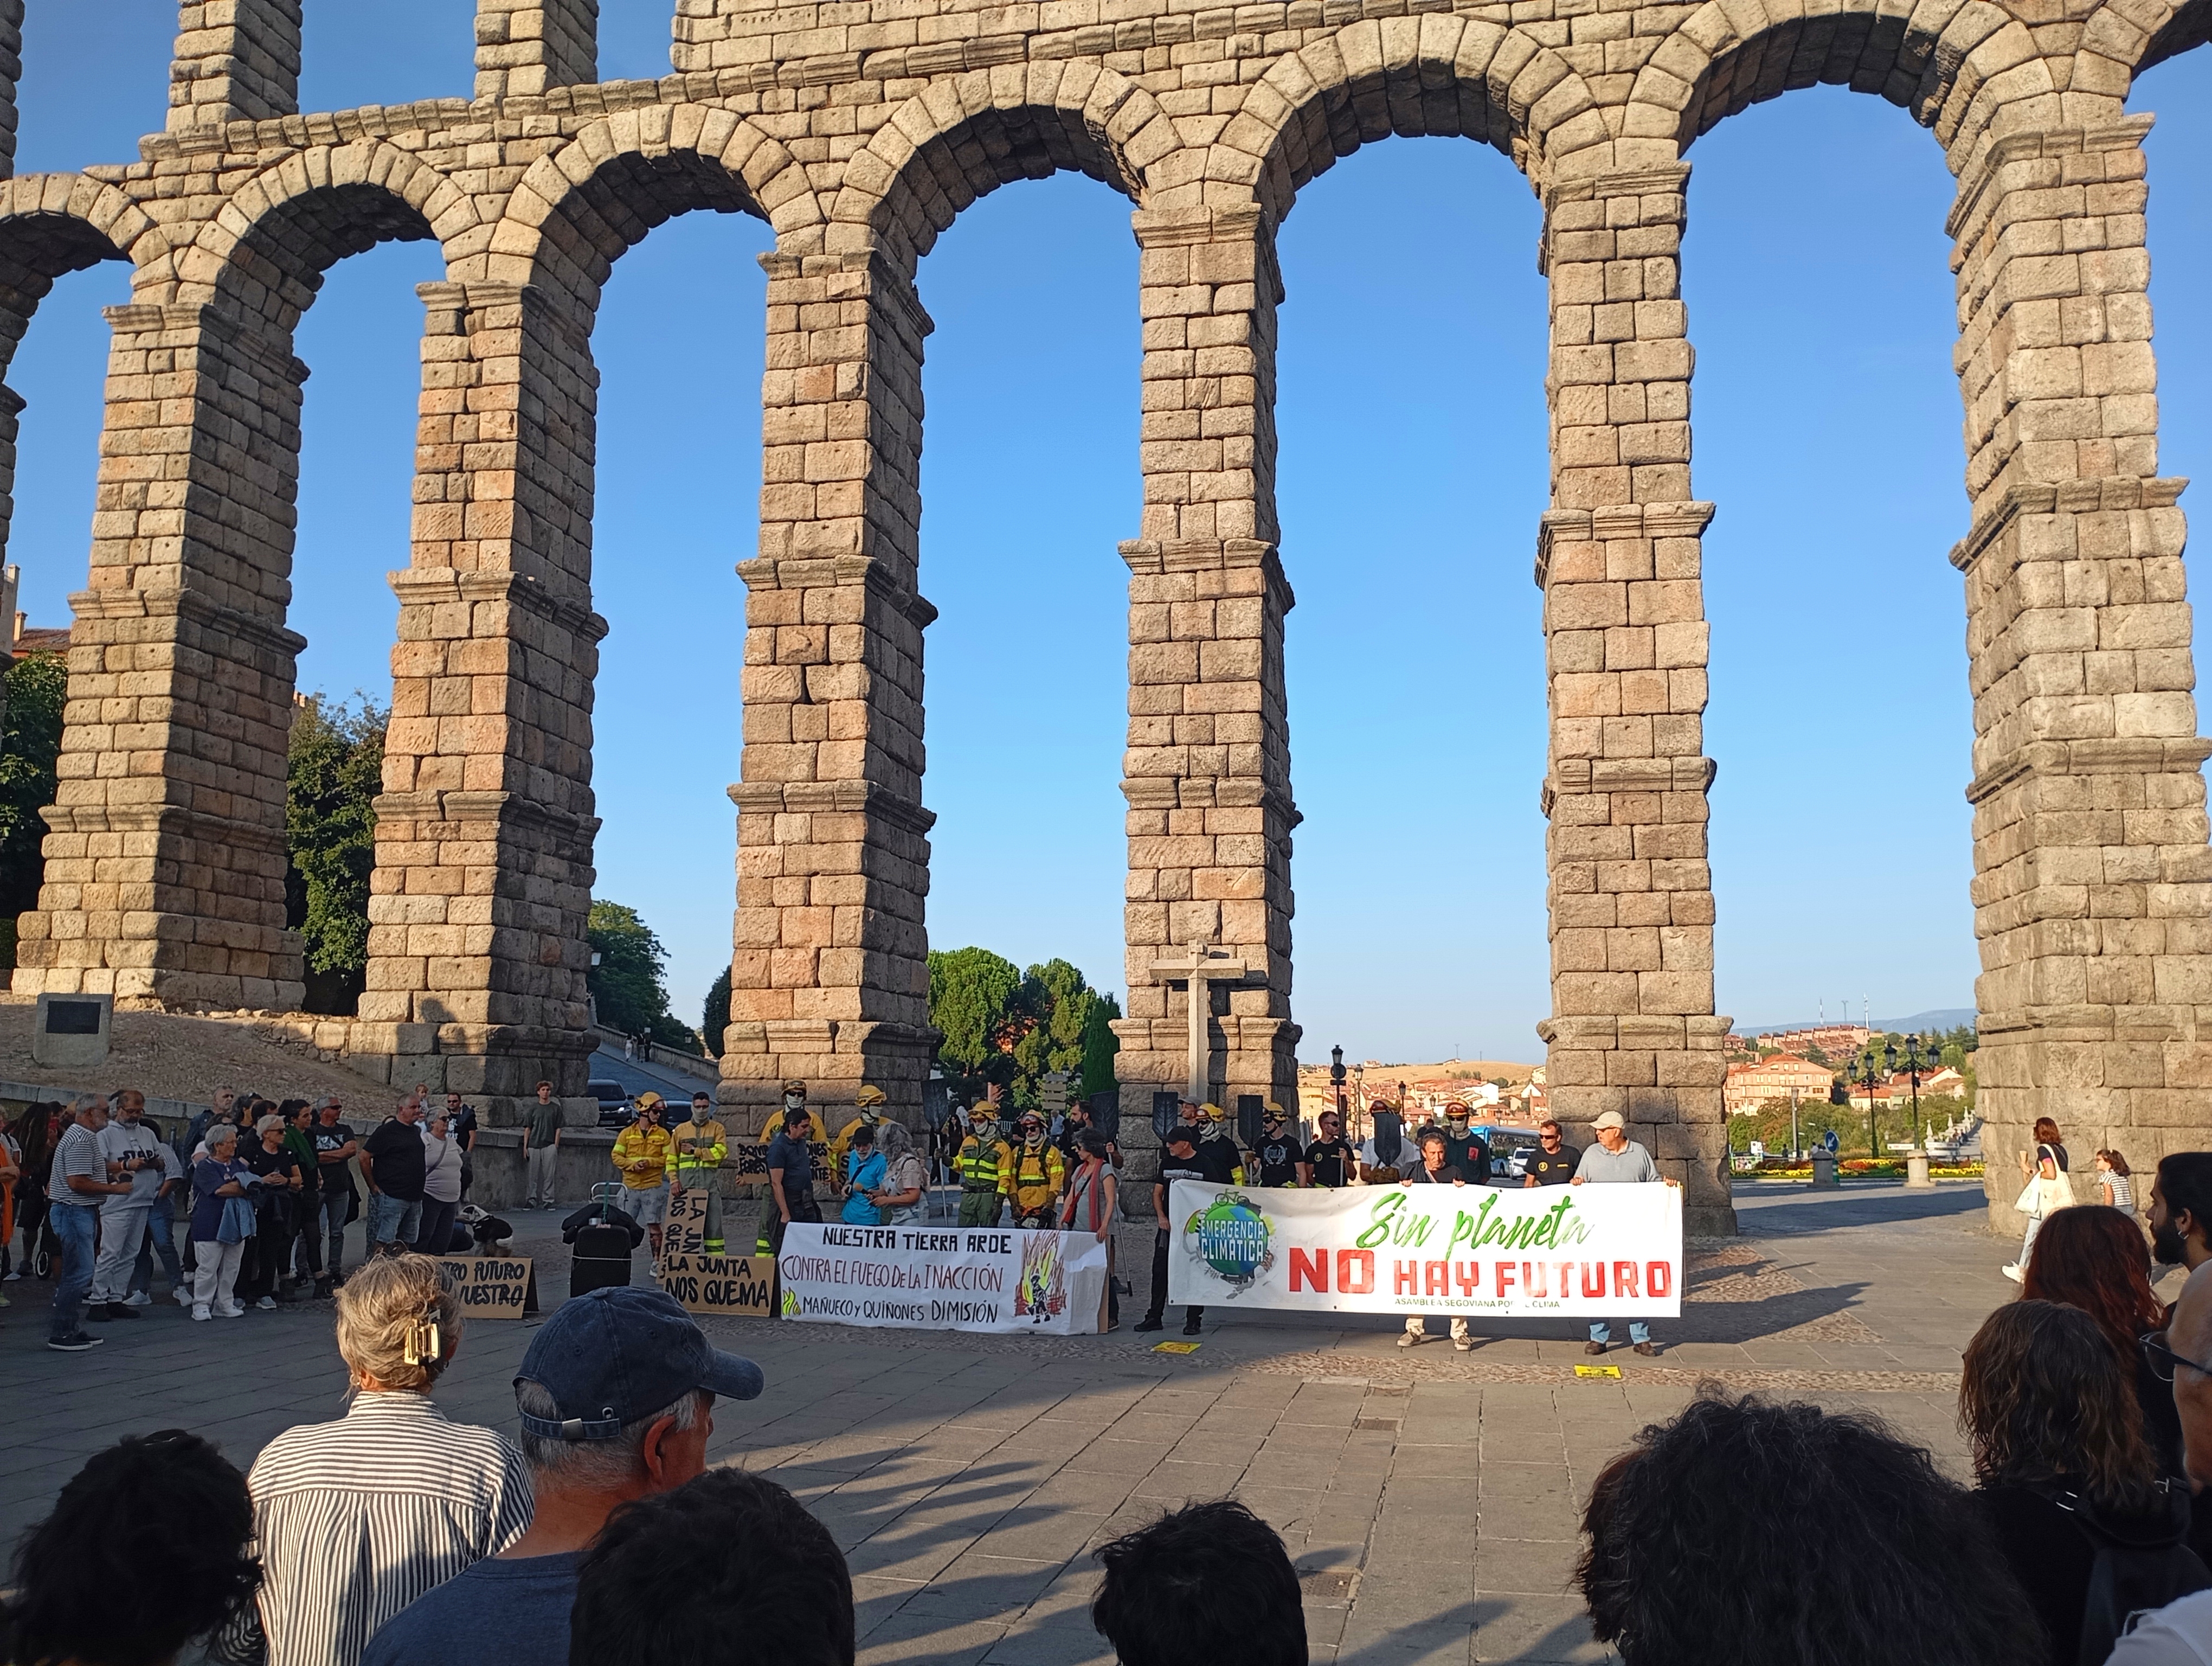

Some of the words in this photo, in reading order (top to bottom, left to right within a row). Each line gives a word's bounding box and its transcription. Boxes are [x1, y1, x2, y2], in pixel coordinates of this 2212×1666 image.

[689, 1196, 707, 1221] LA
[681, 1227, 702, 1254] JUN
[822, 1226, 896, 1248] NUESTRA
[967, 1234, 1012, 1254] ARDE
[1201, 1220, 1264, 1239] EMERGENCIA
[1356, 1193, 1439, 1248] Sin
[1445, 1193, 1595, 1261] planeta
[1201, 1237, 1263, 1261] CLIMÁTICA
[474, 1260, 525, 1282] FUTURO
[668, 1255, 689, 1271] LA
[696, 1255, 751, 1279] JUNTA
[781, 1255, 831, 1283] CONTRA
[834, 1260, 848, 1284] EL
[851, 1260, 890, 1287] FUEGO
[908, 1264, 921, 1289] LA
[924, 1263, 1004, 1292] INACCIÓN
[1289, 1248, 1374, 1293] NO
[1394, 1260, 1479, 1297] HAY
[1495, 1261, 1671, 1298] FUTURO
[665, 1276, 699, 1303] NOS
[704, 1279, 769, 1308] QUEMA
[803, 1296, 853, 1316] MAÑUECO
[931, 1300, 998, 1323] DIMISIÓN
